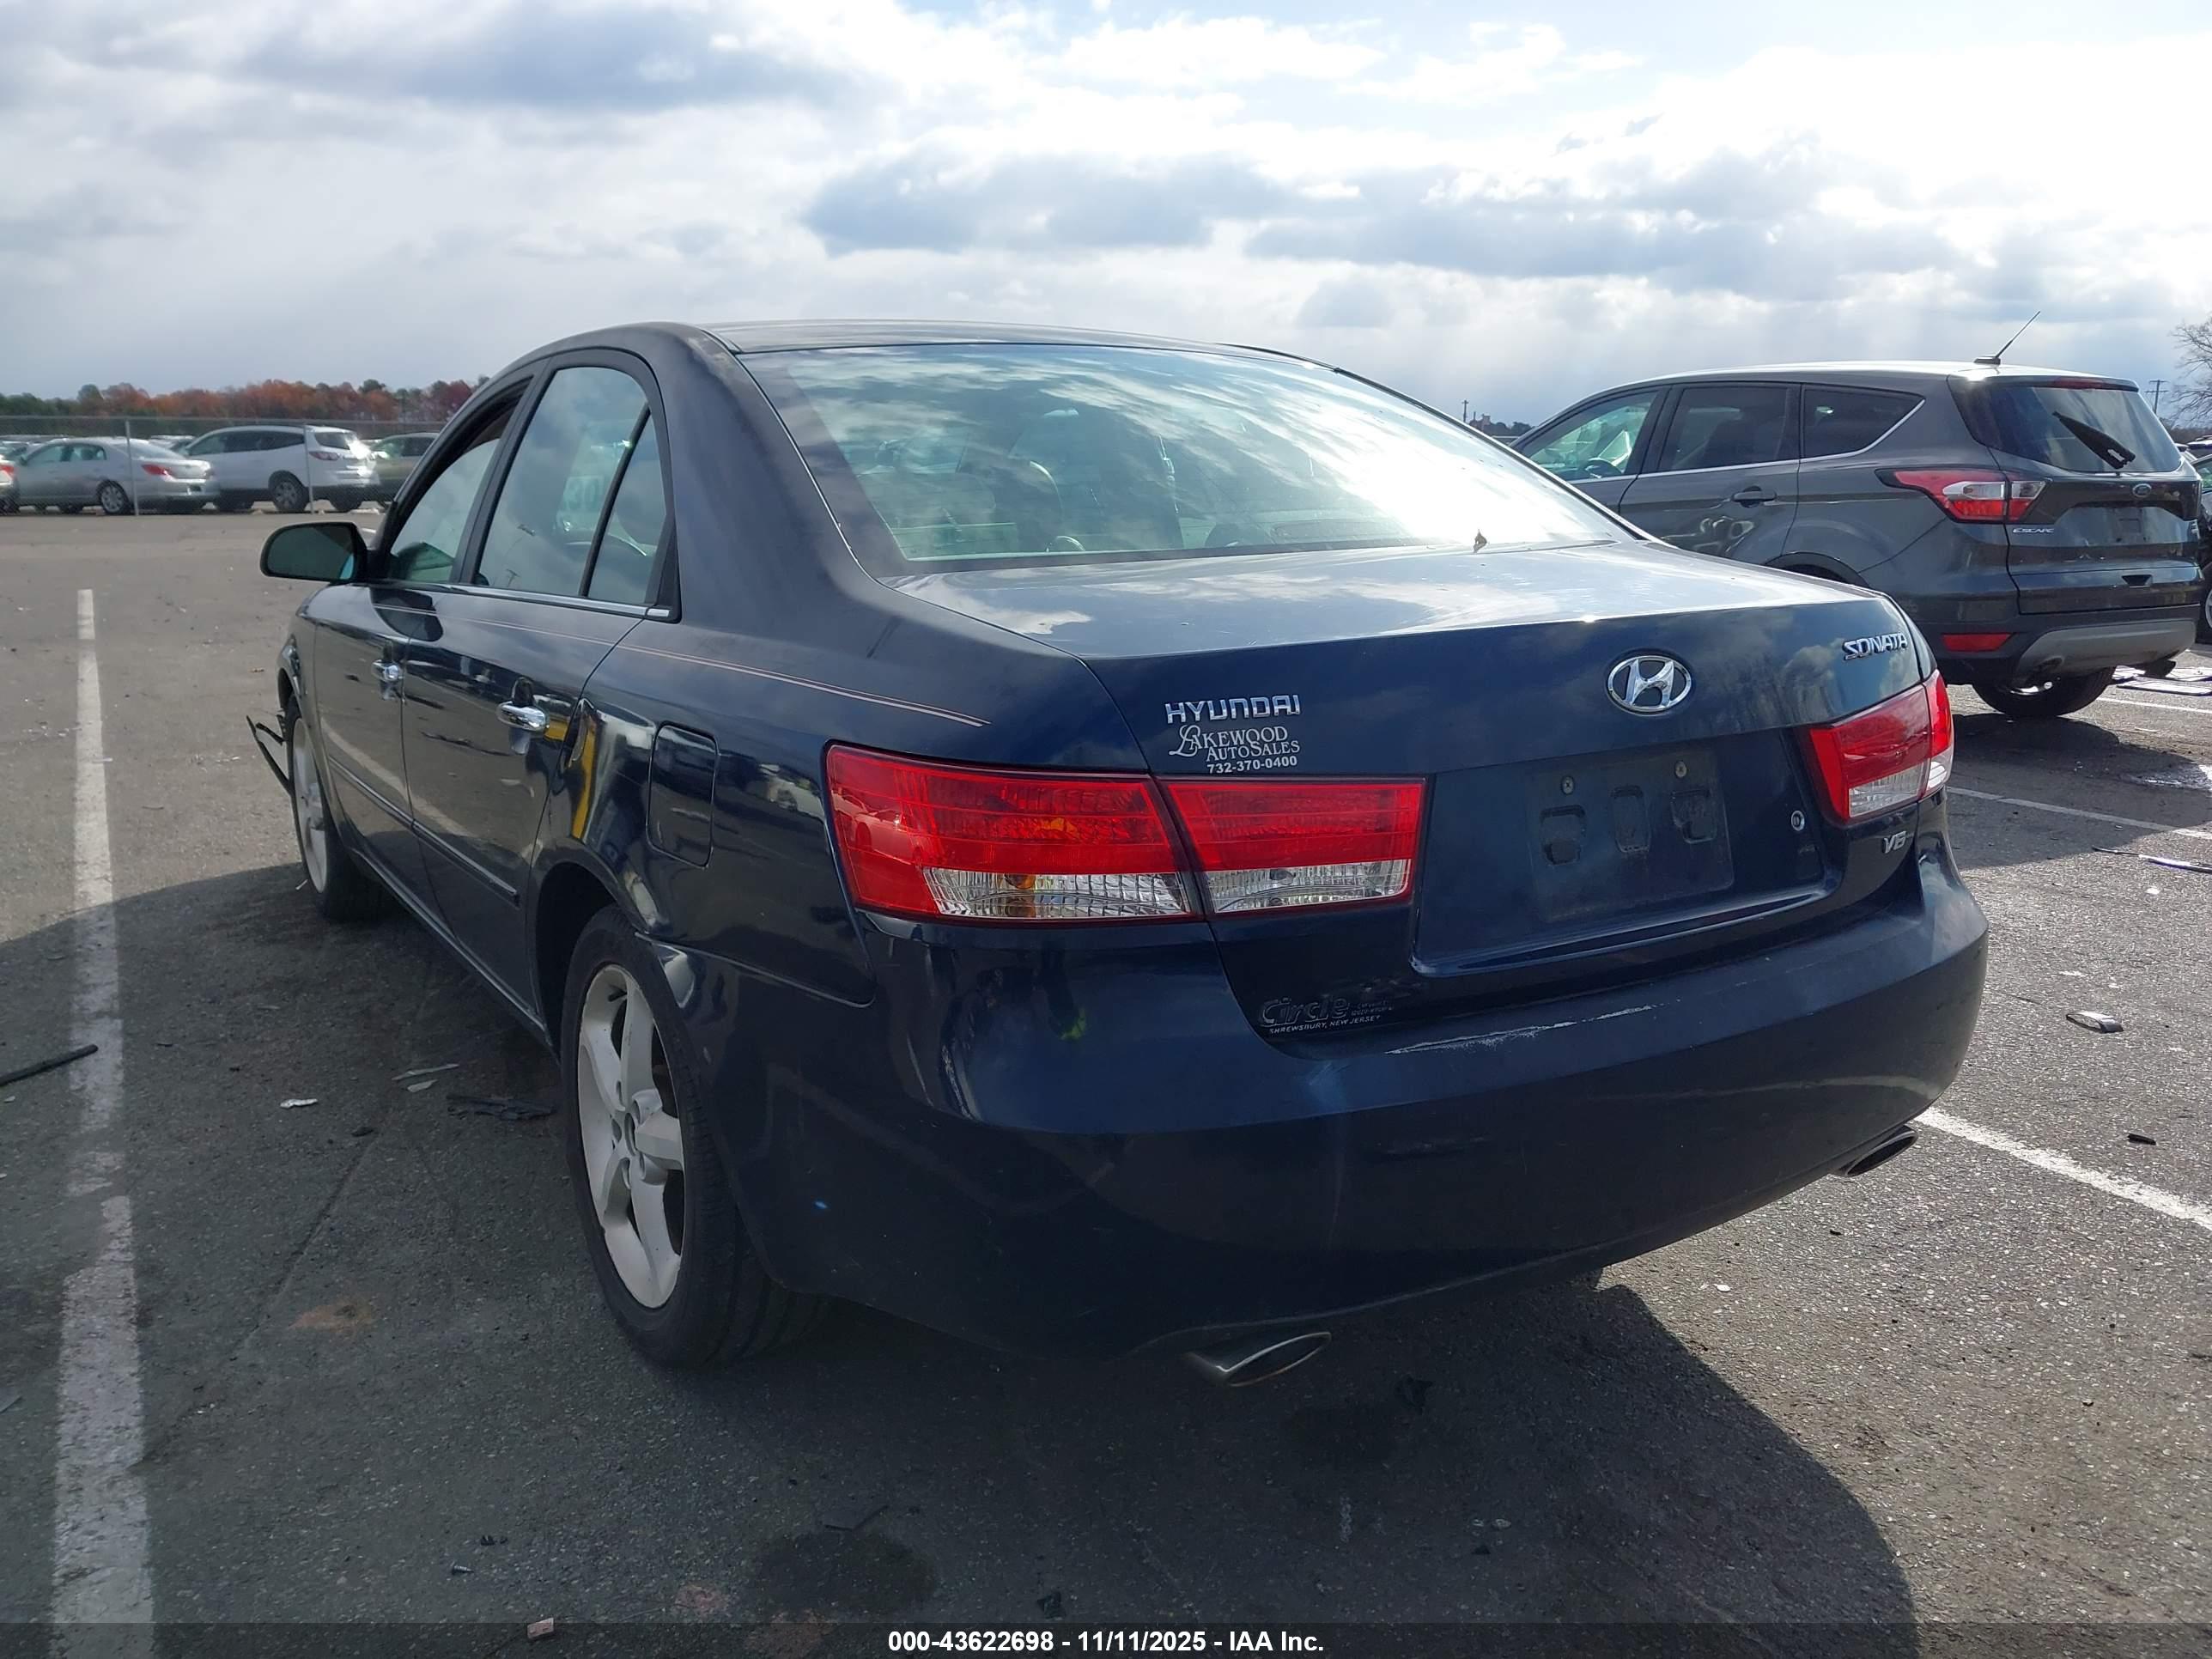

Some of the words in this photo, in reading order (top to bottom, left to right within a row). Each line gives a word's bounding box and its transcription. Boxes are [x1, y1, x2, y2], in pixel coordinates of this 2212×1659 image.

[1844, 632, 1907, 659] SONATA
[1164, 694, 1301, 724] HYUNDAI
[1169, 725, 1288, 757] LAKEWOOD
[1206, 755, 1297, 774] 732-370-0400
[1883, 830, 1906, 854] V6
[1330, 1018, 1348, 1027] NEW
[1349, 1015, 1381, 1024] JERSEY
